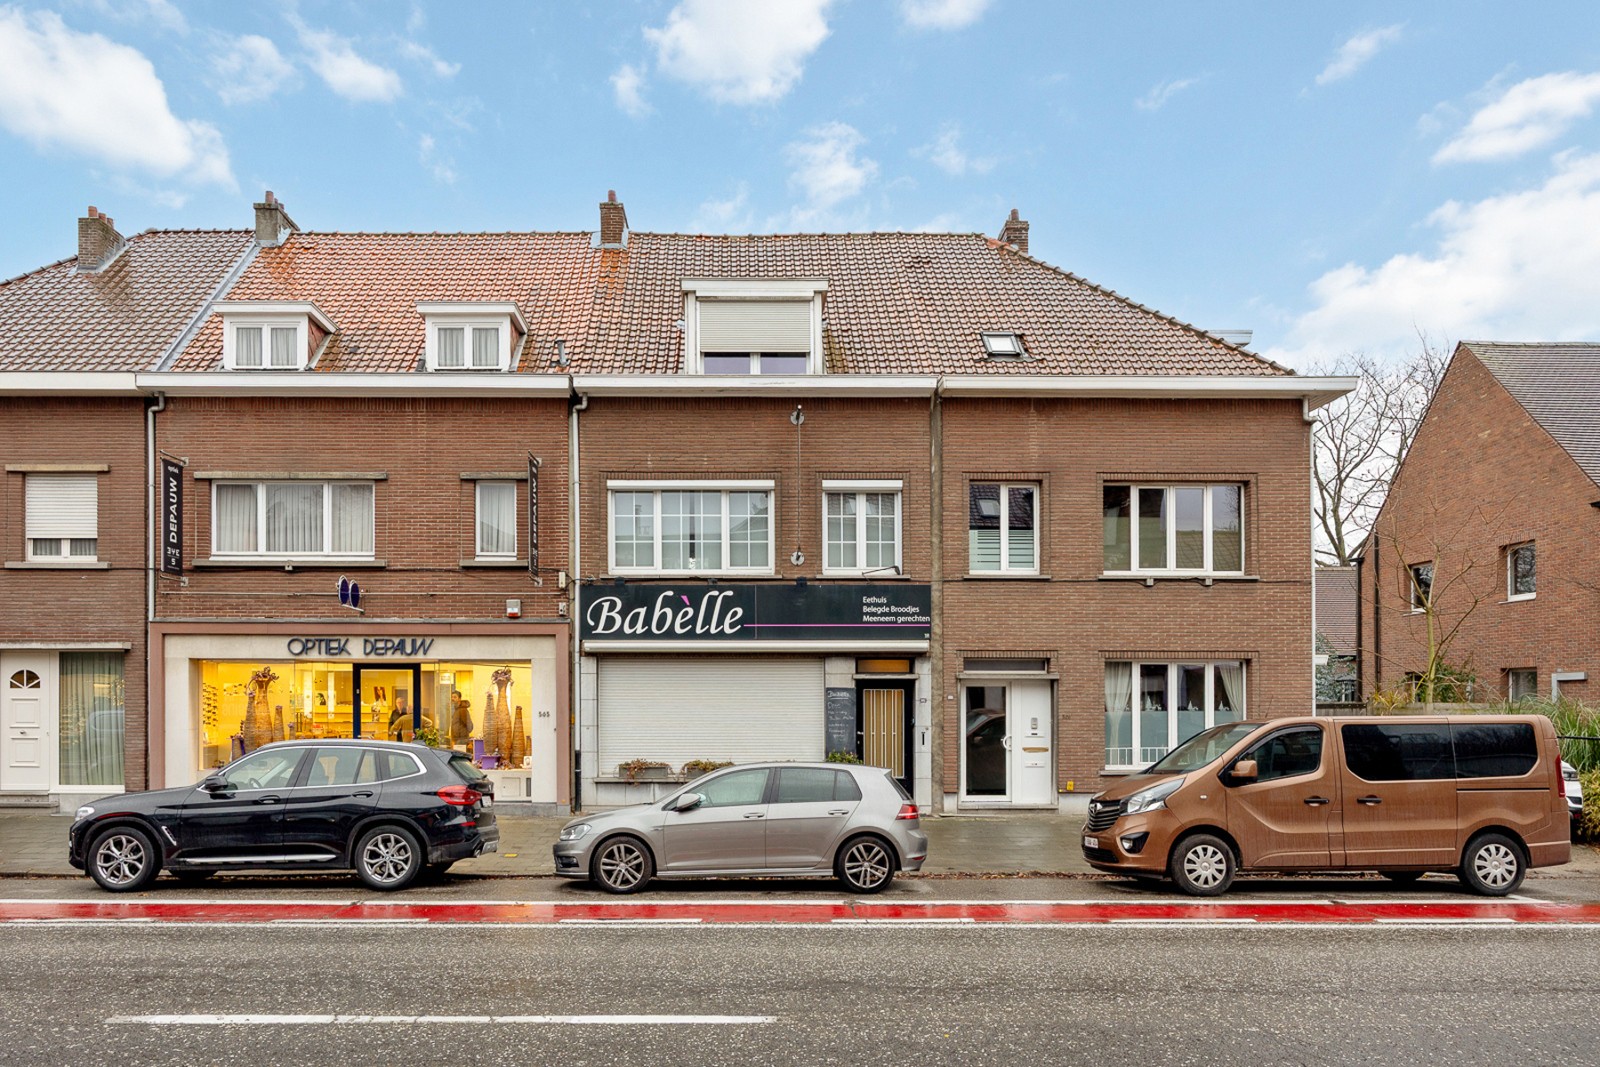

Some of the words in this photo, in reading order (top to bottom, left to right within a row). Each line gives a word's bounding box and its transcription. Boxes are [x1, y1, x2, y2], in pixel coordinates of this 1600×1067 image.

[169, 477, 178, 543] DEPAUW
[862, 596, 888, 604] Eethuis
[587, 590, 744, 635] Babèlle
[862, 605, 890, 614] Belegde
[890, 605, 920, 614] Broodjes
[896, 614, 931, 623] gerechten
[287, 637, 351, 656] OPTIEK
[363, 637, 435, 656] DEPAUW
